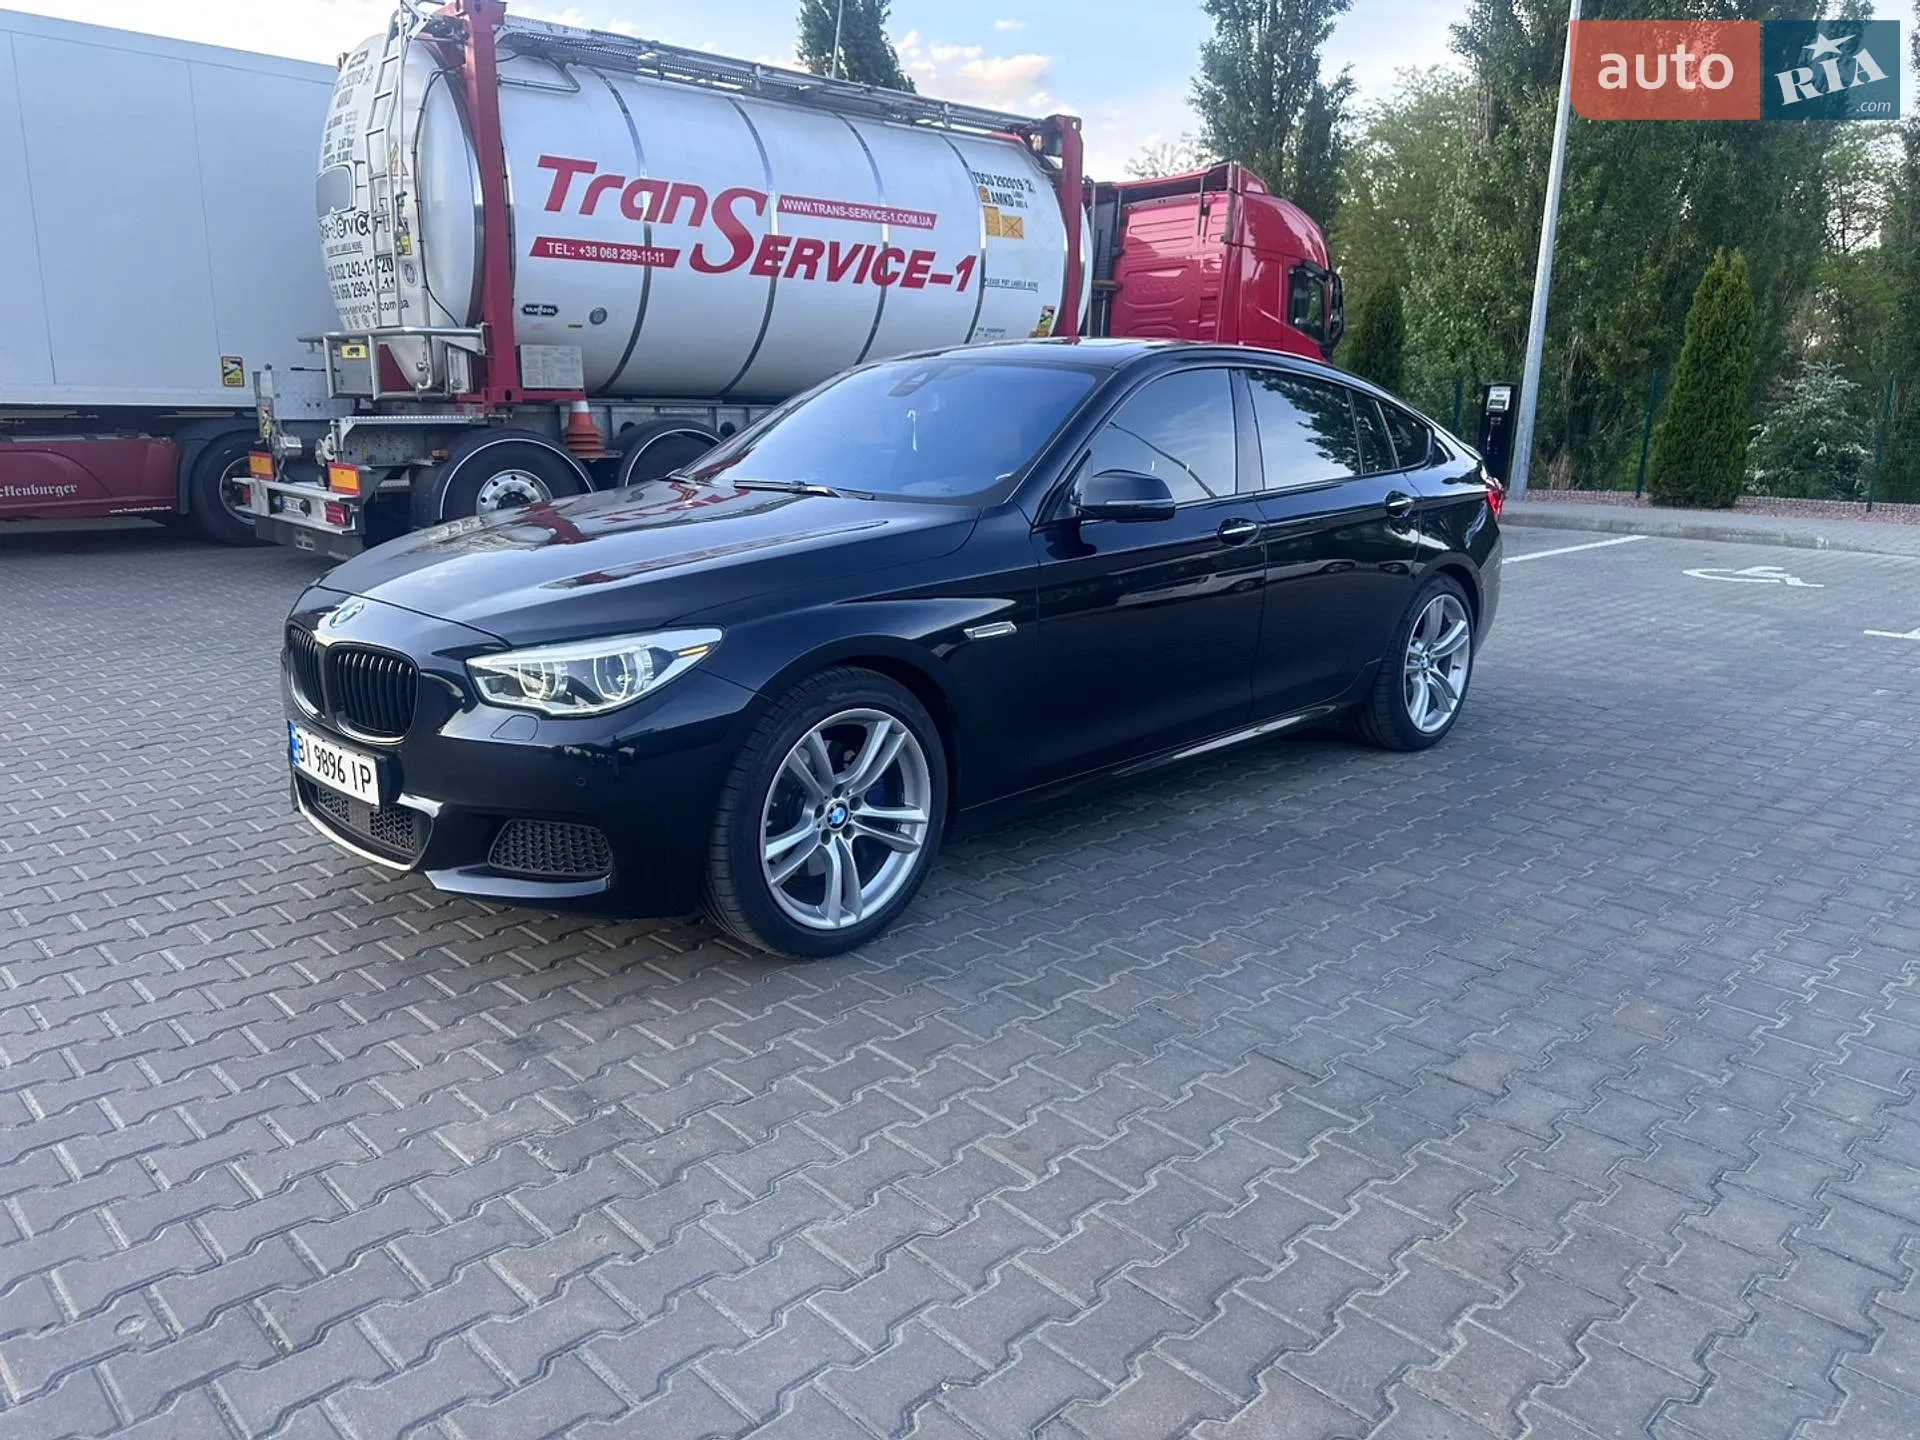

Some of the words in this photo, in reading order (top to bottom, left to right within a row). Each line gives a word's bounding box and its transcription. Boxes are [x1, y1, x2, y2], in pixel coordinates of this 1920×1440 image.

[782, 199, 932, 227] WWW.TRANS-SERVICE-1.COM.UA
[546, 242, 575, 256] TEL:
[579, 245, 597, 258] +38
[600, 247, 619, 260] 068
[620, 249, 665, 264] 299-11-11
[314, 744, 346, 784] 9896
[352, 761, 372, 793] IP
